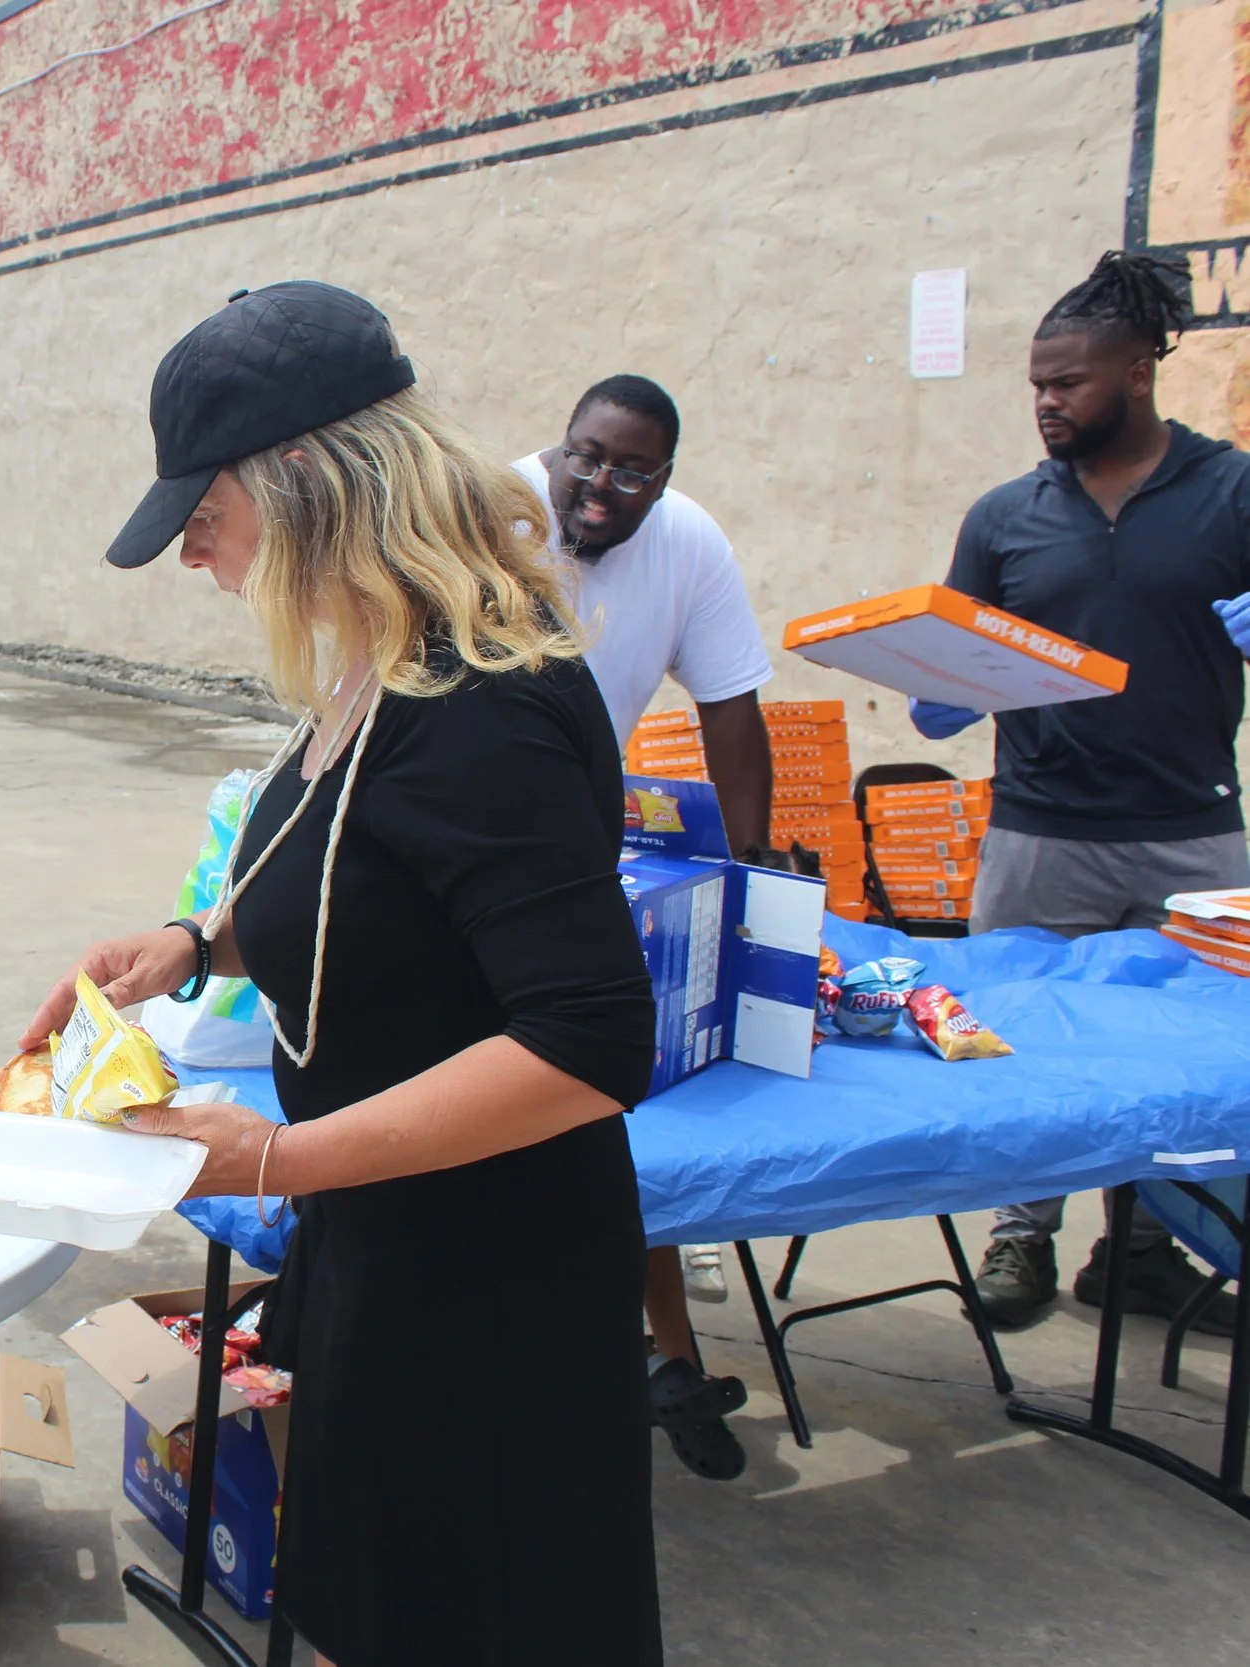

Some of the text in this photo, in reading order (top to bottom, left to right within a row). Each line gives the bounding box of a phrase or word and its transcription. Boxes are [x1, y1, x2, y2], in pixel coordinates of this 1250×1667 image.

[973, 610, 1084, 668] HOT-N-READY
[851, 988, 915, 1012] RUFF
[123, 1082, 142, 1099] CRISPY
[216, 1530, 233, 1561] 50
